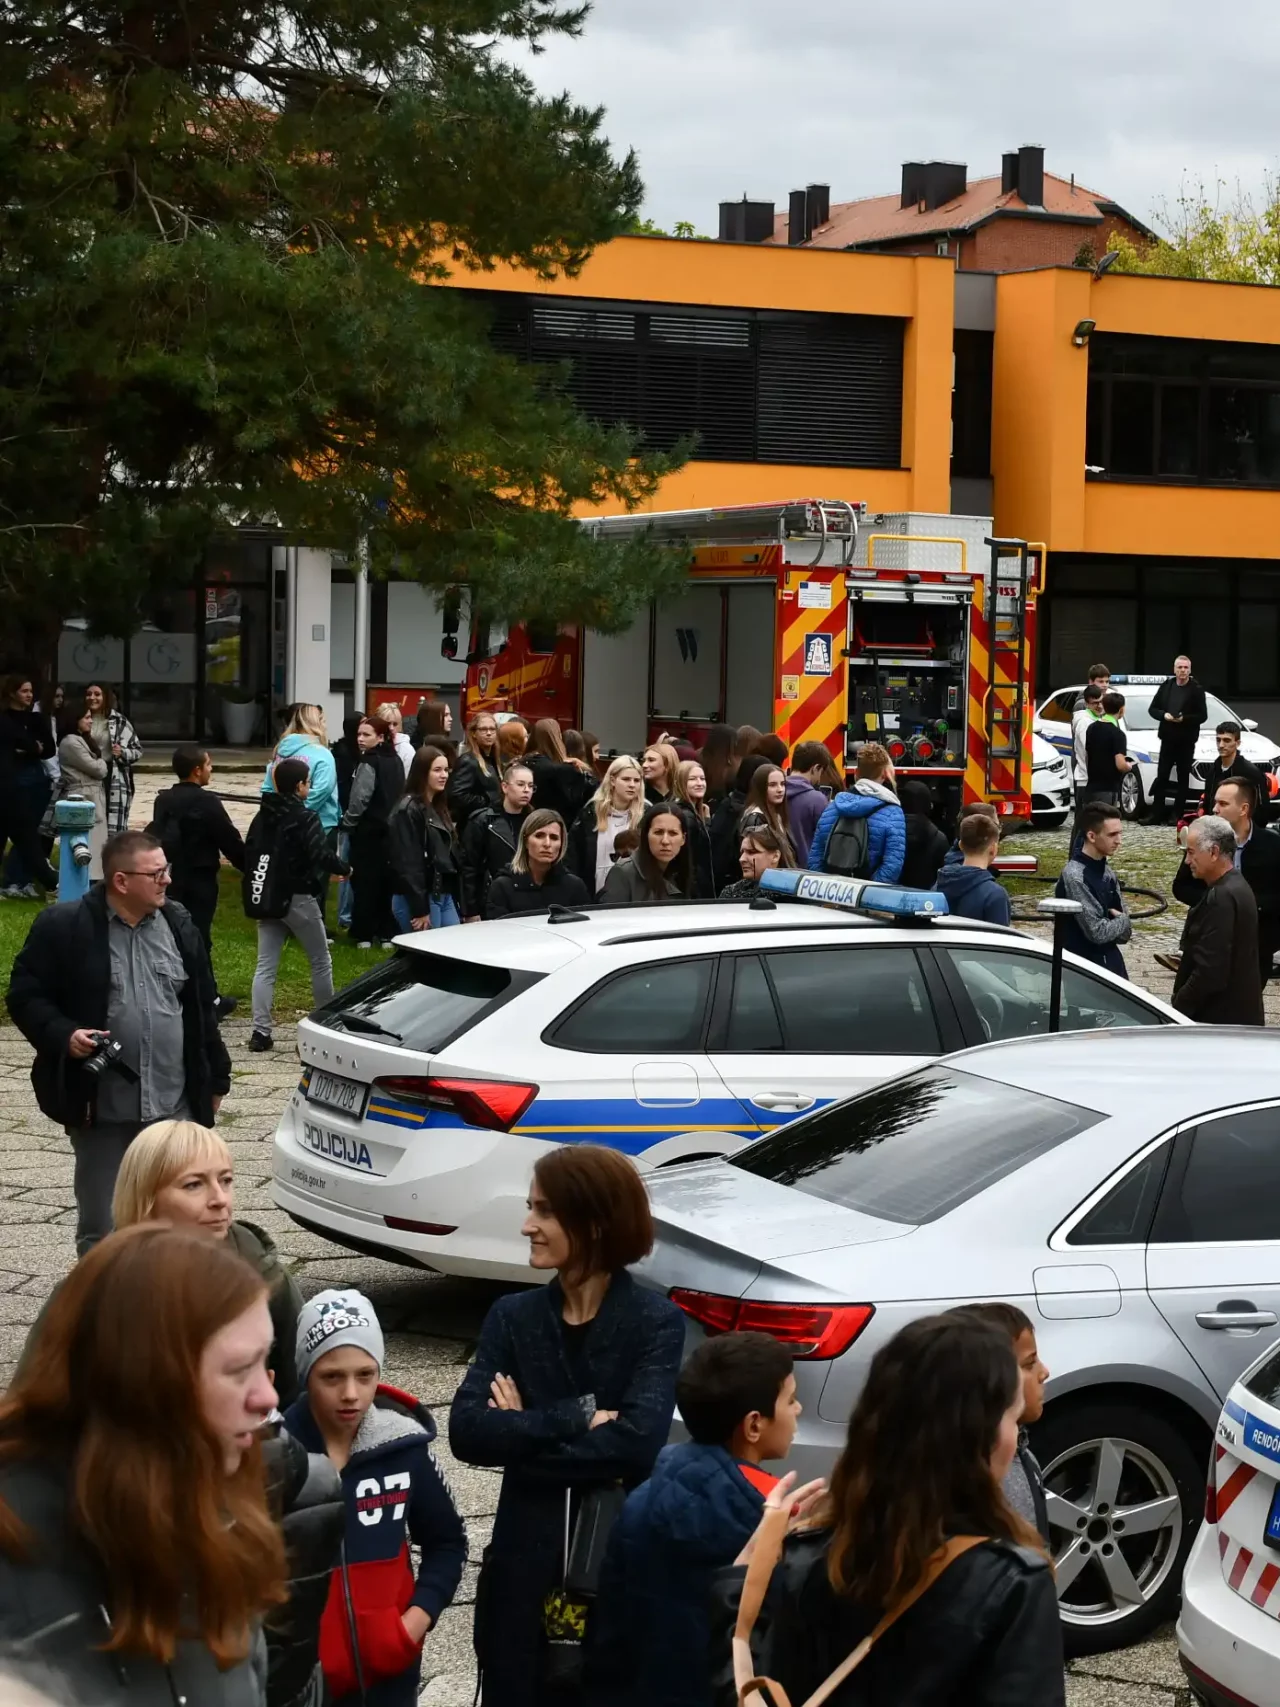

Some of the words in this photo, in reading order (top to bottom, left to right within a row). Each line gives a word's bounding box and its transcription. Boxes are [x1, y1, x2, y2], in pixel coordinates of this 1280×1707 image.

[1130, 676, 1165, 684] POLICIJA
[251, 854, 270, 905] adidas
[800, 879, 854, 904] POLICIJA
[337, 1082, 357, 1109] 708
[303, 1120, 373, 1169] POLICIJA
[291, 1167, 327, 1189] policija.gov.hr
[306, 1322, 323, 1340] I'M
[306, 1331, 325, 1350] THE
[322, 1315, 369, 1335] BOSS
[1273, 1517, 1280, 1531] H
